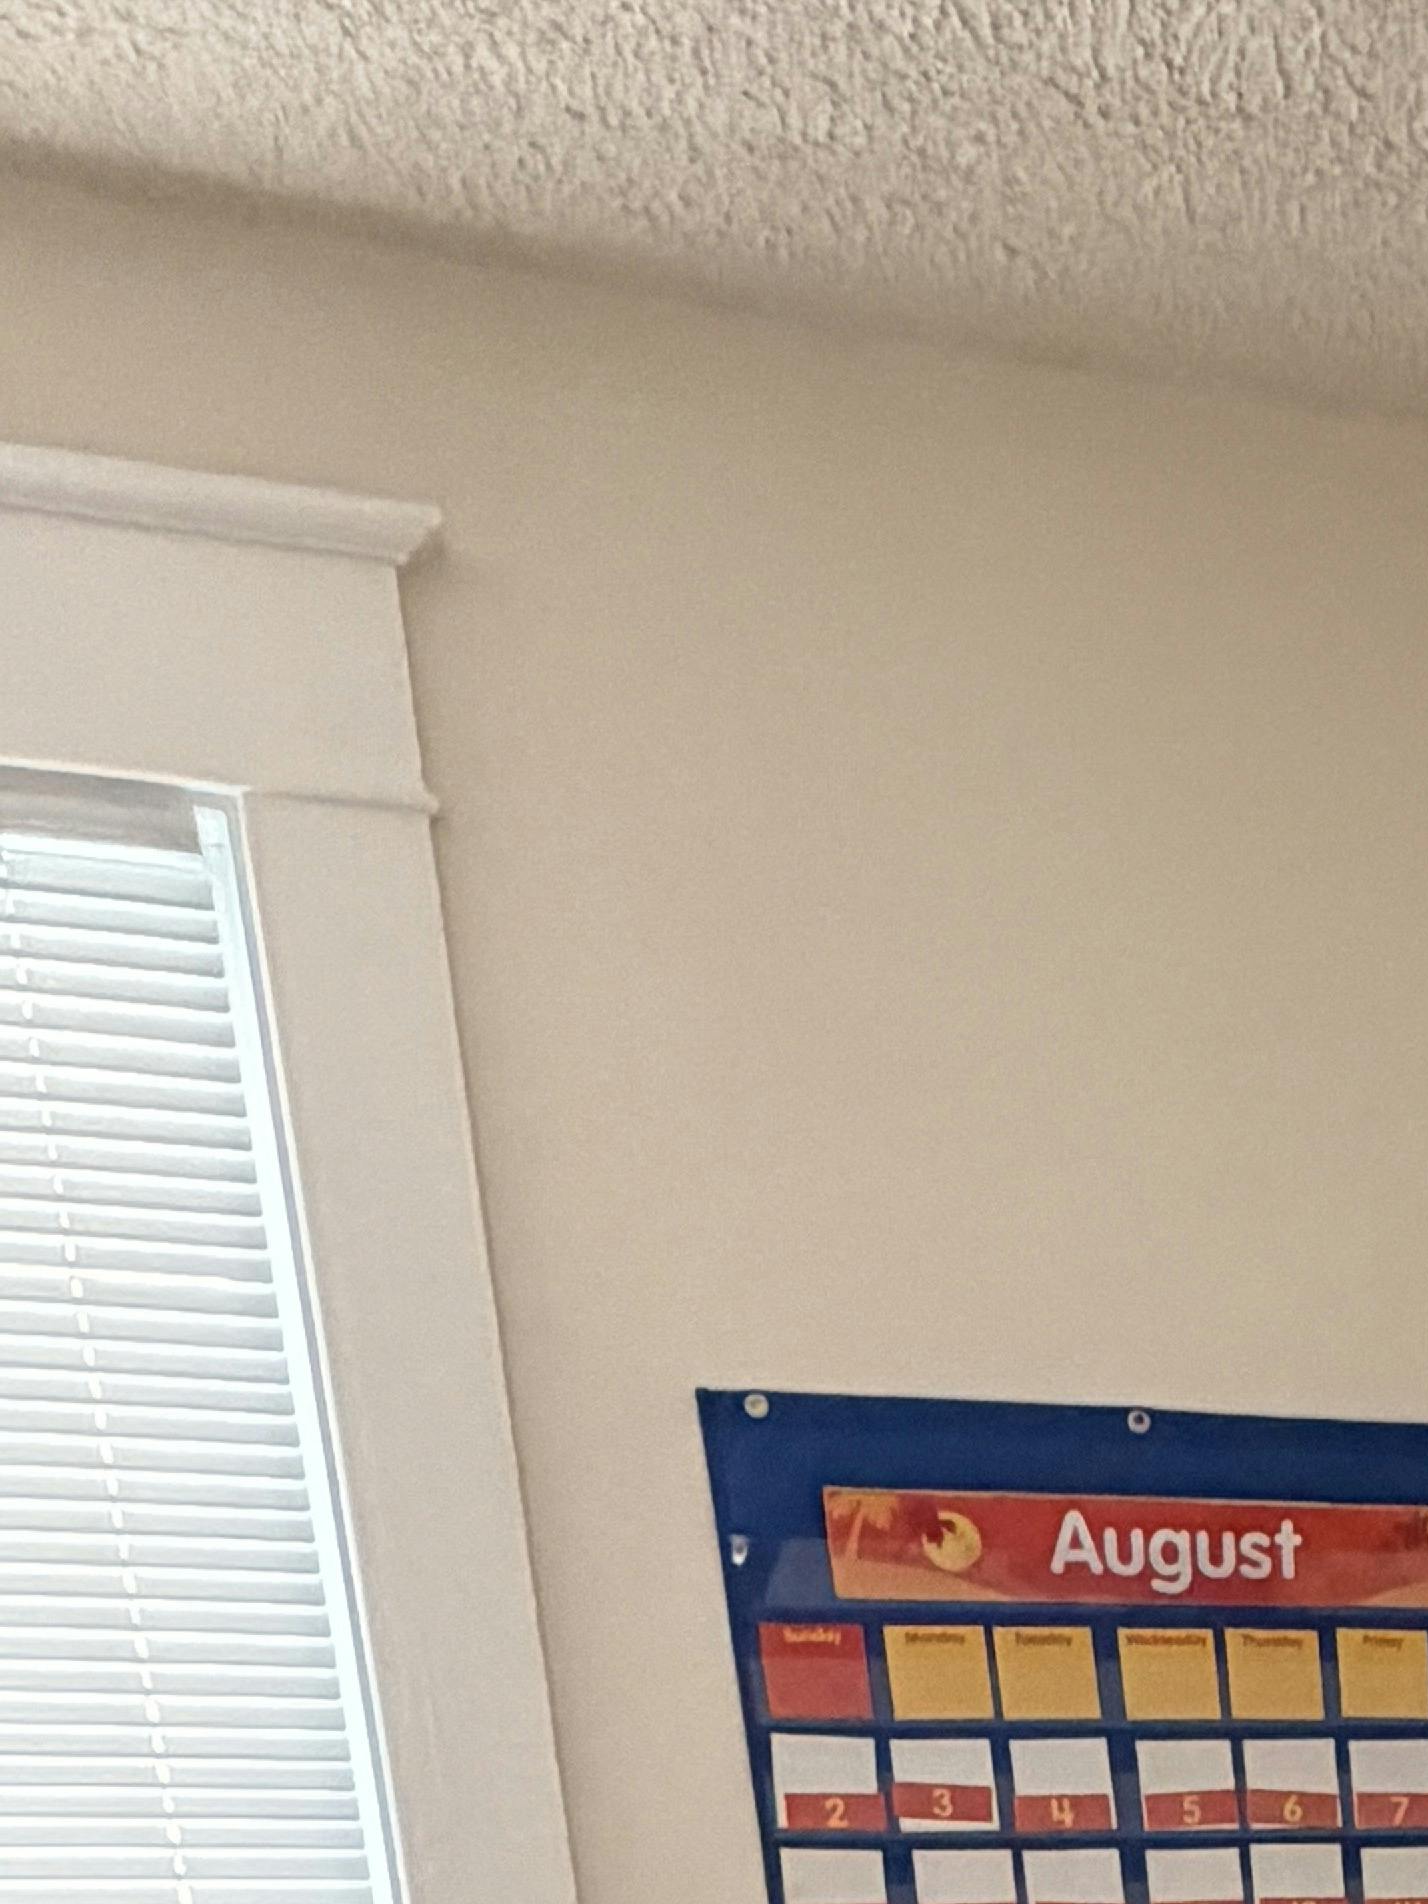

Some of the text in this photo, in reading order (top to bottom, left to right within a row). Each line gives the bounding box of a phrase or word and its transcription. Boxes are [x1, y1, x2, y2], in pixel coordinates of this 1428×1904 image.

[1051, 1510, 1302, 1594] August
[825, 1798, 849, 1827] 2
[932, 1789, 953, 1817] 3
[1050, 1798, 1075, 1828] 4
[1182, 1796, 1201, 1824] 5
[1283, 1796, 1303, 1820] 6
[1390, 1797, 1411, 1824] 7
